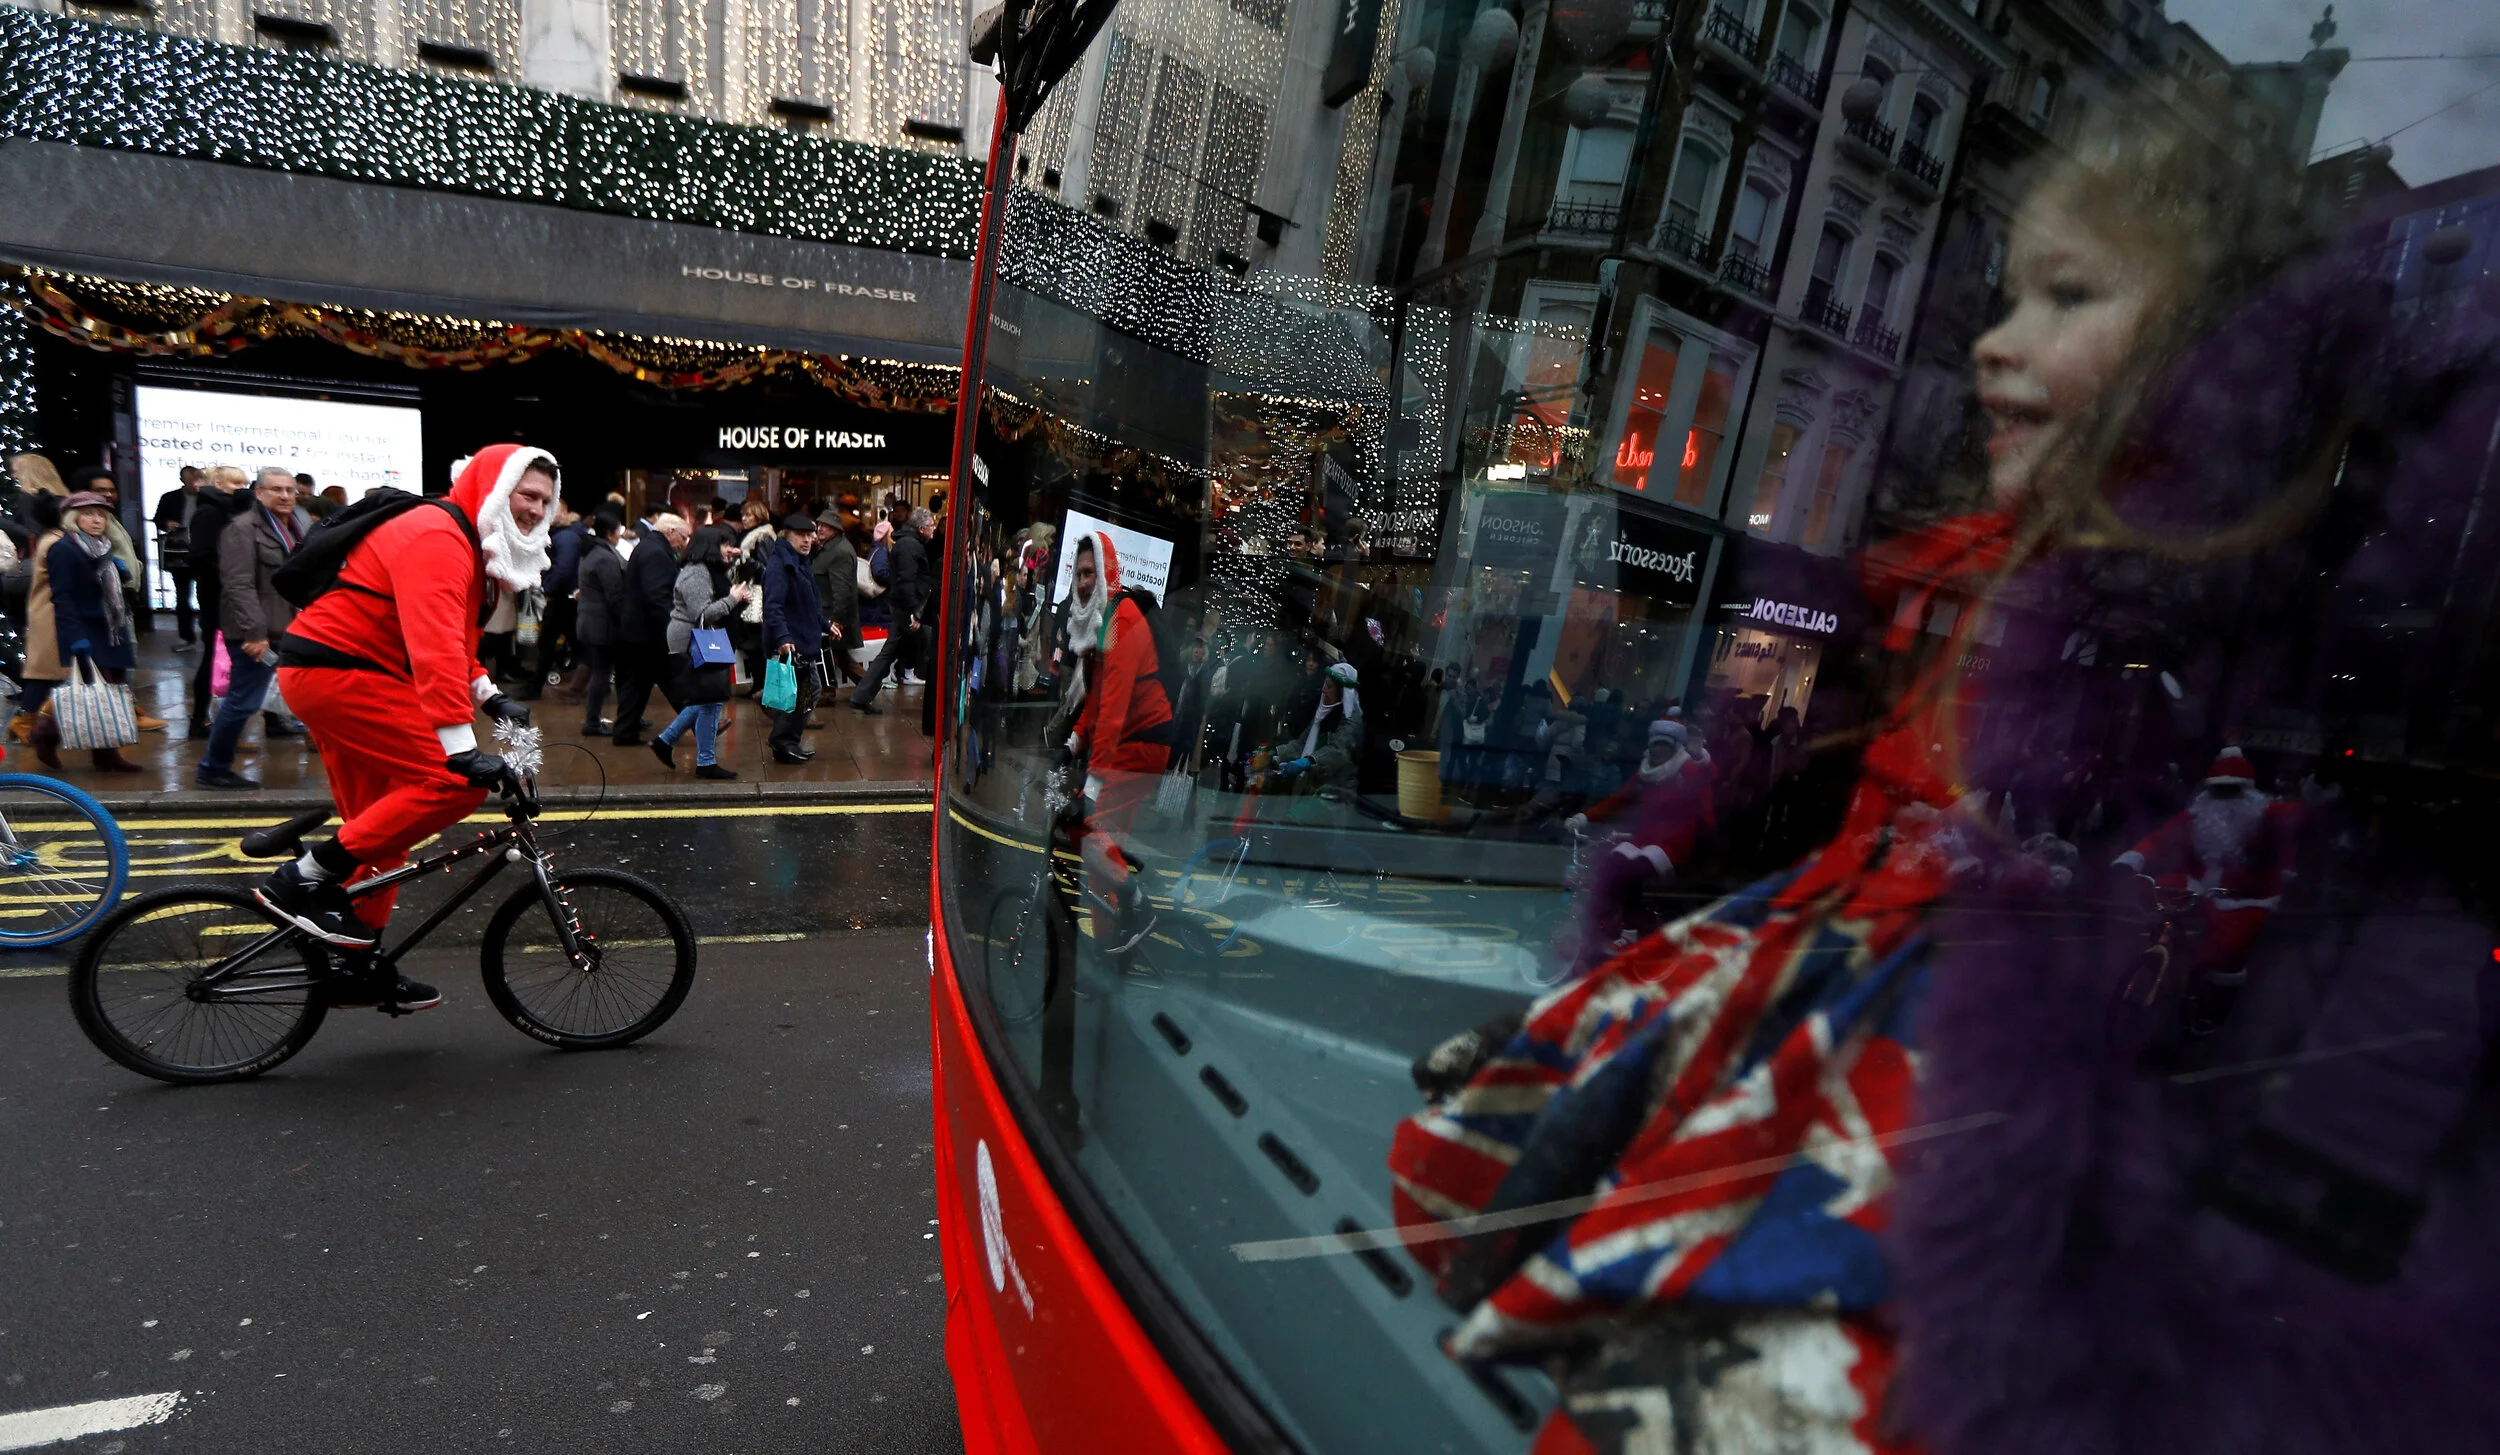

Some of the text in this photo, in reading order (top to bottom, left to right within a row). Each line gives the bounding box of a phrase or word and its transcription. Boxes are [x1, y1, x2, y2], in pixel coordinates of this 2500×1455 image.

[682, 265, 918, 303] HOUSE OF FRASER
[141, 416, 203, 433] remier
[140, 436, 204, 452] ocated
[210, 442, 234, 454] on
[240, 441, 283, 457] level
[290, 446, 300, 458] 2
[719, 426, 886, 449] HOUSE OF FRASER
